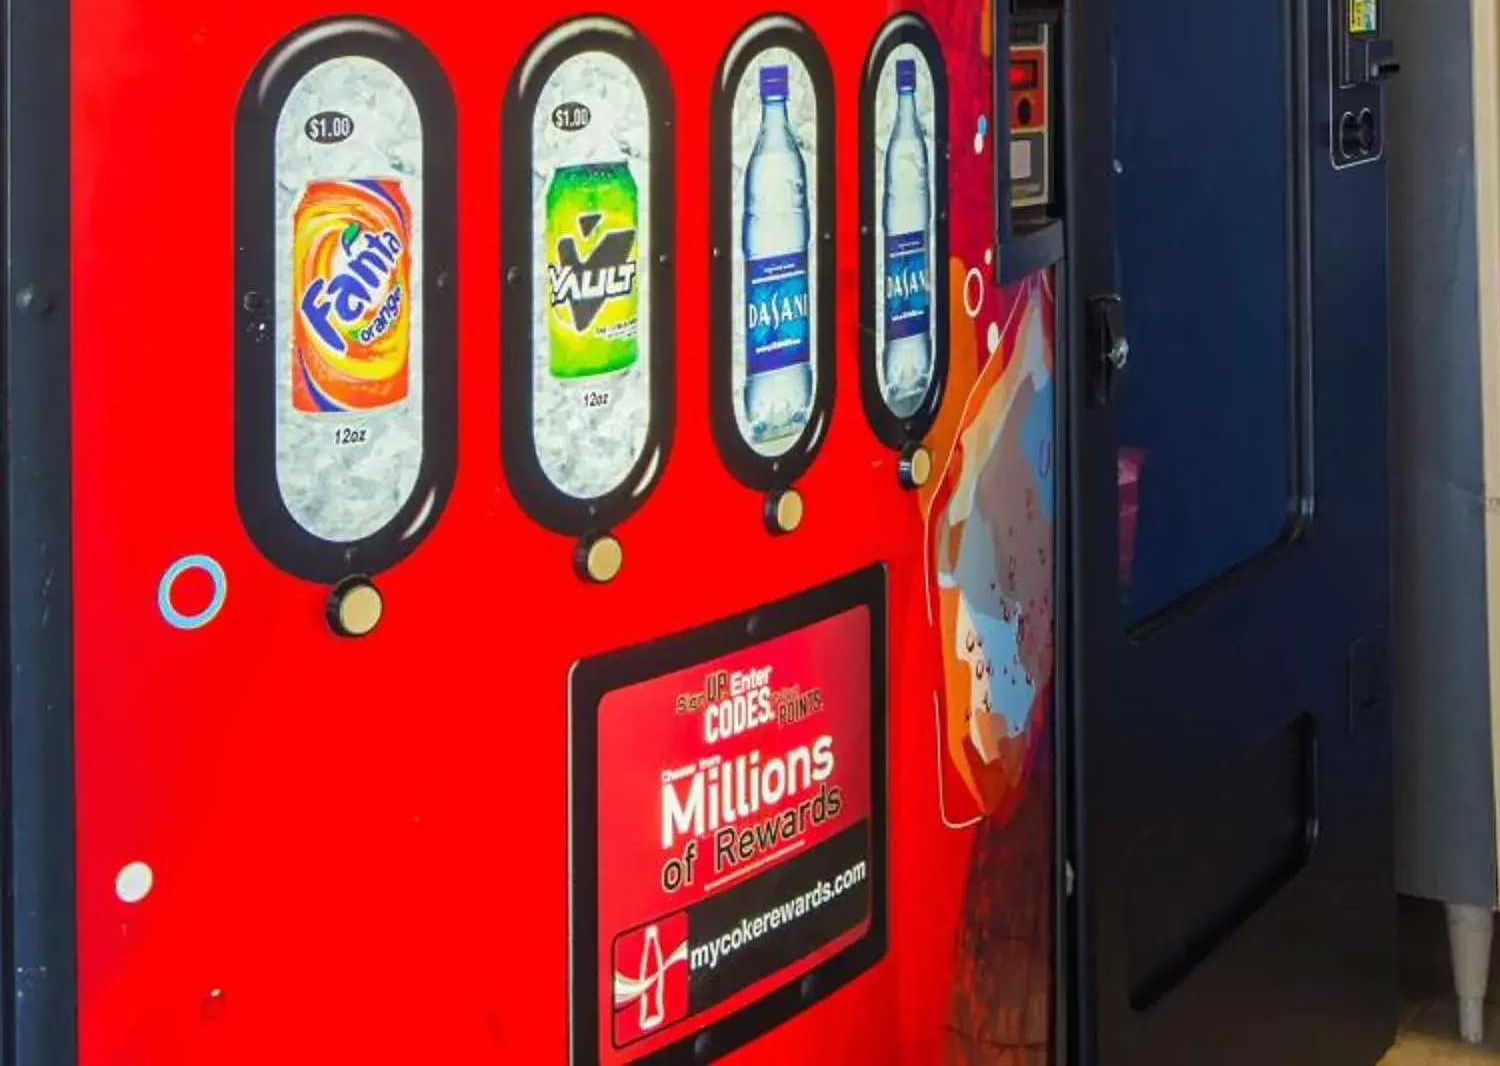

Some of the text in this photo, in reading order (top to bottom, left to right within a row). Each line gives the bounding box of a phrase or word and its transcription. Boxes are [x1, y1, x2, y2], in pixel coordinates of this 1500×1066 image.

[308, 117, 351, 138] $1.00
[555, 108, 589, 128] $1.00
[300, 228, 403, 354] Fanta
[548, 260, 637, 306] VAULT
[359, 282, 402, 342] orange
[584, 392, 609, 407] 12oz
[335, 428, 367, 445] 12oz
[730, 665, 773, 695] Enter
[660, 734, 836, 850] Millions
[661, 784, 843, 893] of Rewards
[690, 860, 867, 970] mycokerewards.com
